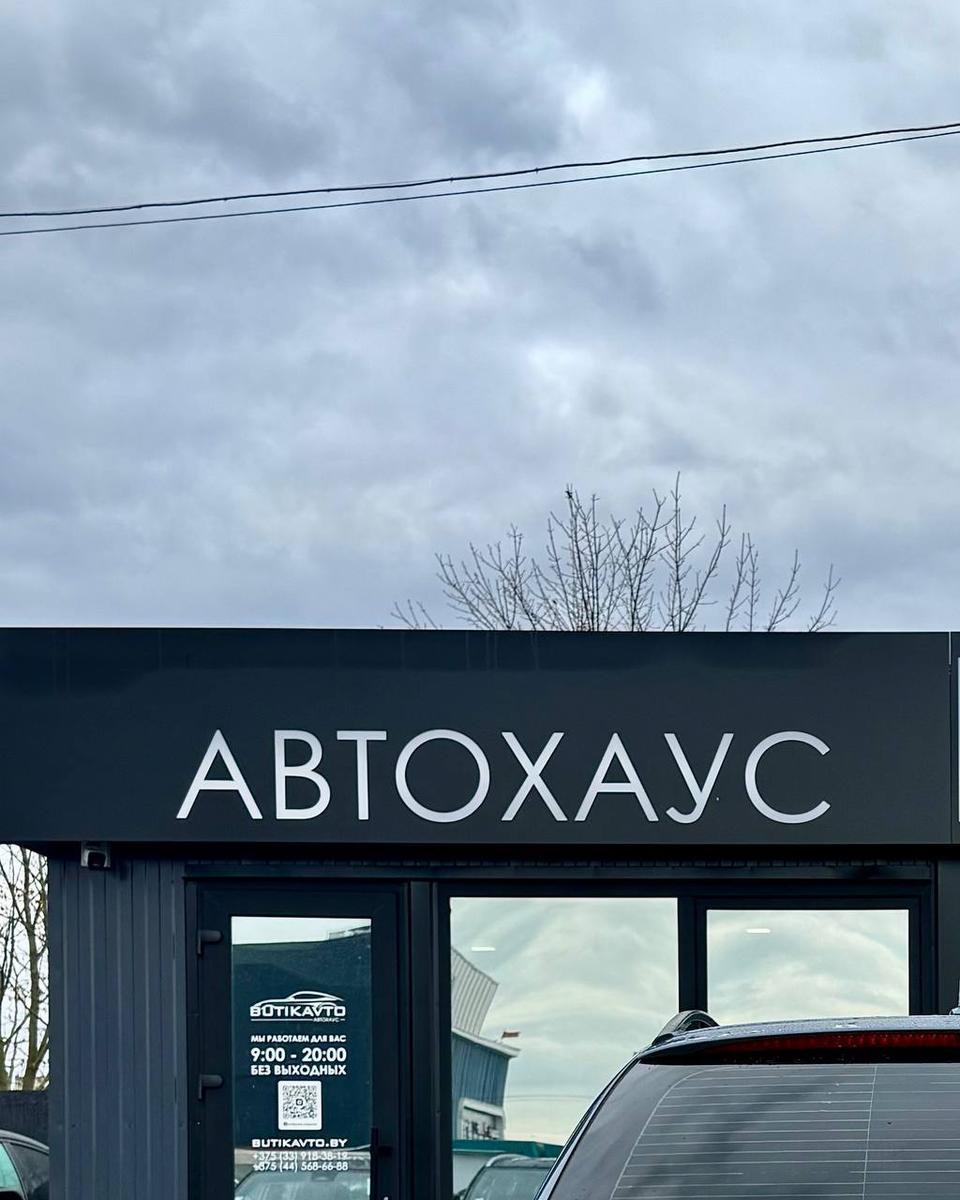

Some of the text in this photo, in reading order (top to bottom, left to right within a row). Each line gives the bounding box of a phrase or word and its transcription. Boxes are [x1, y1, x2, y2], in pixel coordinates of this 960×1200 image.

[176, 729, 831, 825] АВТОХАУС
[250, 1006, 346, 1017] BUTIKAVTO
[311, 1035, 327, 1043] ДЛЯ
[250, 1047, 285, 1062] 9:00
[302, 1047, 347, 1062] 20:00
[251, 1065, 347, 1076] БЕЗ ВЫХОДНЫХ
[252, 1139, 348, 1147] BUTIKAVTO.BY
[279, 1151, 298, 1162] (33)
[279, 1161, 298, 1172] (44)
[301, 1162, 348, 1170] 568-66-88
